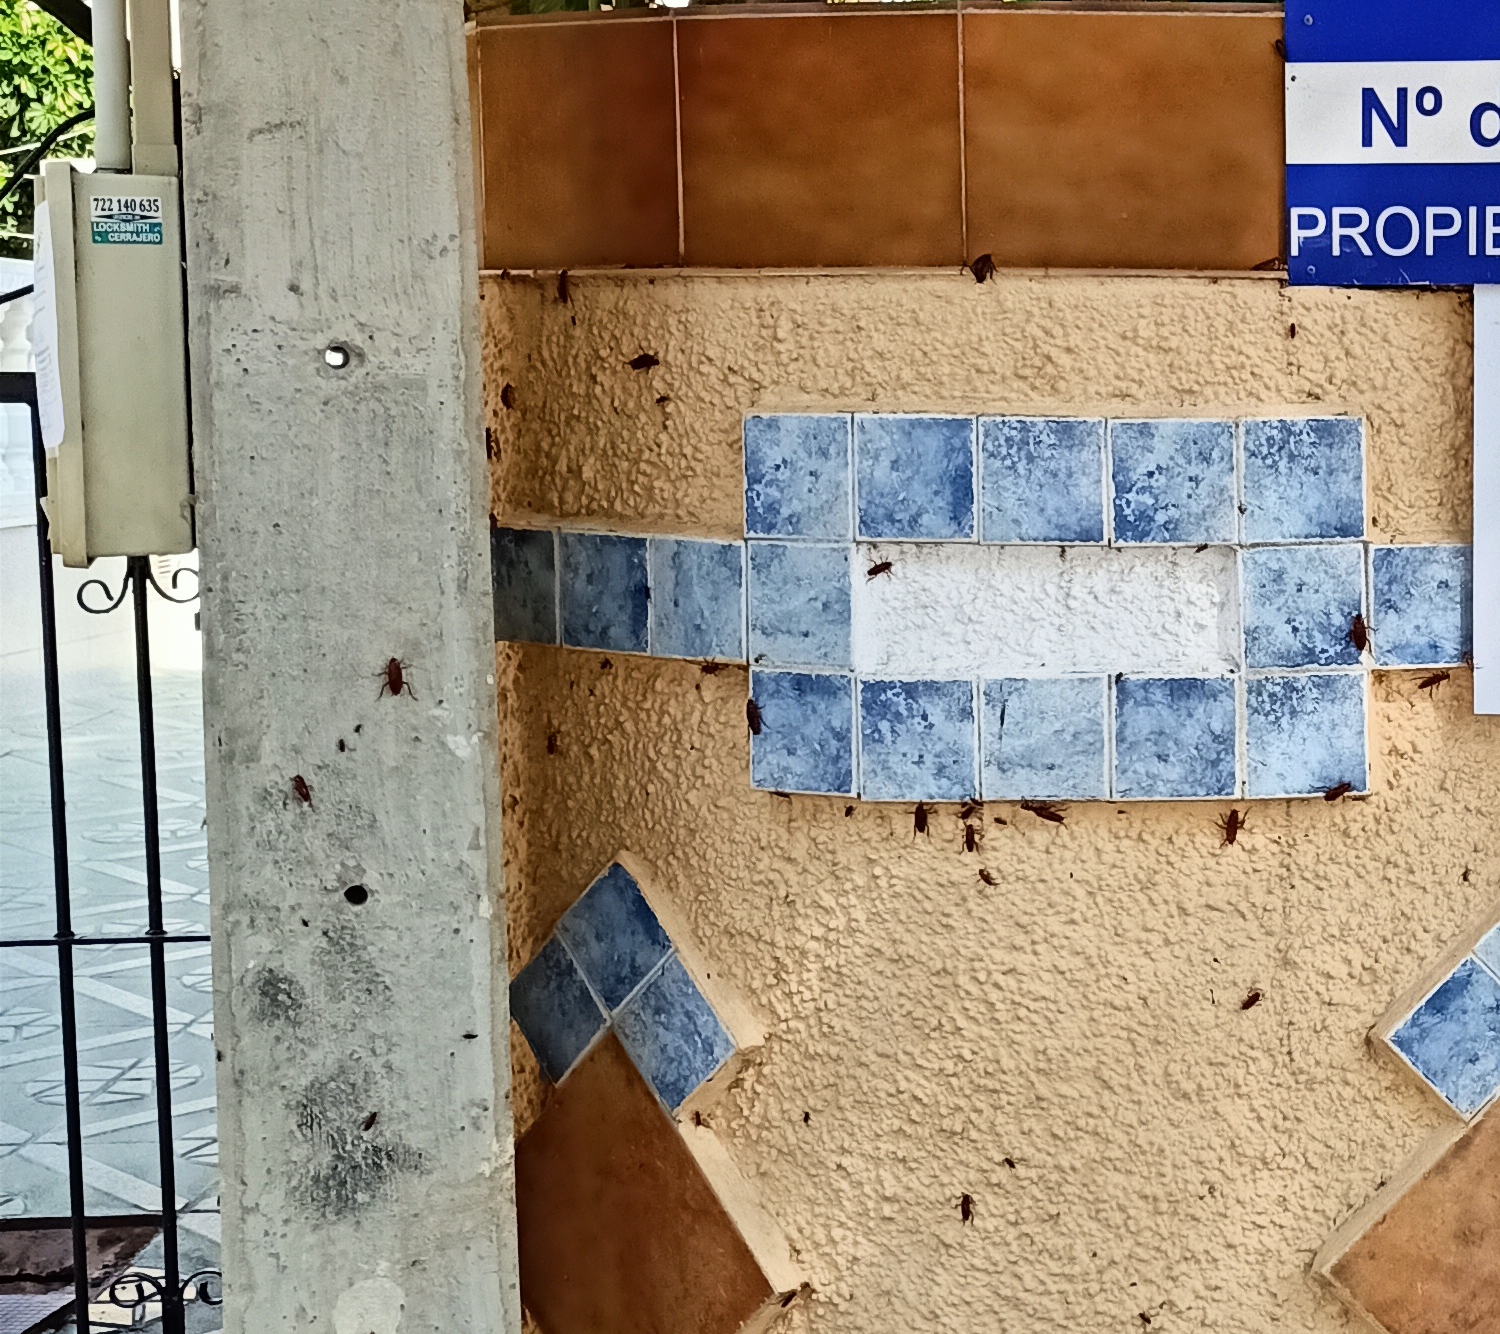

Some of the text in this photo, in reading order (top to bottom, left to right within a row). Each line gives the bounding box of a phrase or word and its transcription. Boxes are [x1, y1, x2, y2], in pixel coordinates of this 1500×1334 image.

[93, 198, 160, 213] 722 140 635
[93, 222, 150, 233] LOCKSMITH
[107, 233, 161, 243] CERRAJERO
